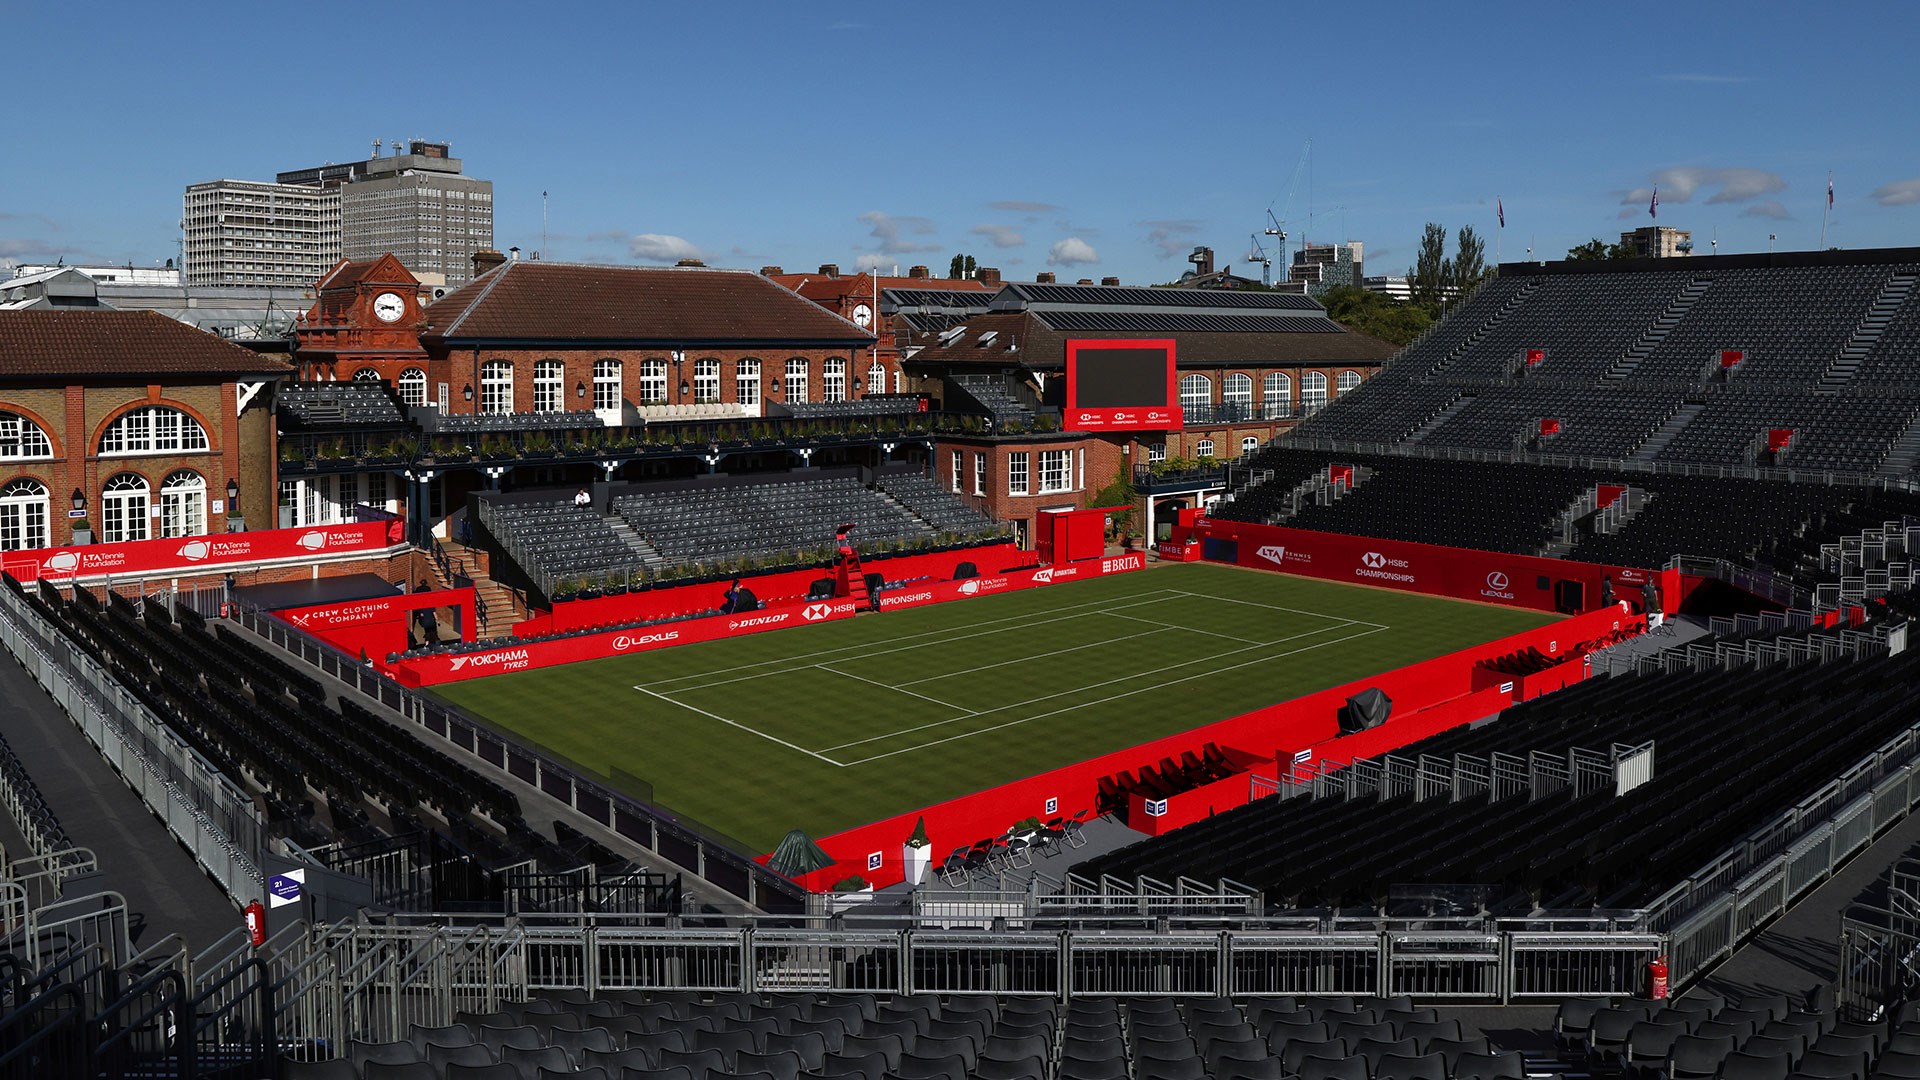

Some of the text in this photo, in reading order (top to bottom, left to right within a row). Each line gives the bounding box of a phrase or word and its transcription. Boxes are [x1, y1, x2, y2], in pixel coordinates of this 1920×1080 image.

[329, 538, 364, 546] Foundation
[100, 552, 125, 560] Tennis
[212, 548, 251, 556] Foundation
[1262, 548, 1311, 561] LTA TENNIS
[83, 559, 125, 568] Foundation
[1112, 556, 1140, 571] BRITA
[1388, 558, 1409, 568] HSBC
[1355, 568, 1415, 583] CHAMPIONSHIPS
[880, 592, 932, 606] MPIONSHIPS
[1480, 589, 1514, 599] LEXUS
[312, 602, 390, 618] CREW CLOTHING
[329, 612, 374, 624] COMPANY
[739, 613, 789, 628] DUNLOP
[631, 631, 679, 645] LEXUS
[469, 649, 529, 667] YOKOHAMA
[503, 659, 529, 670] TYRES
